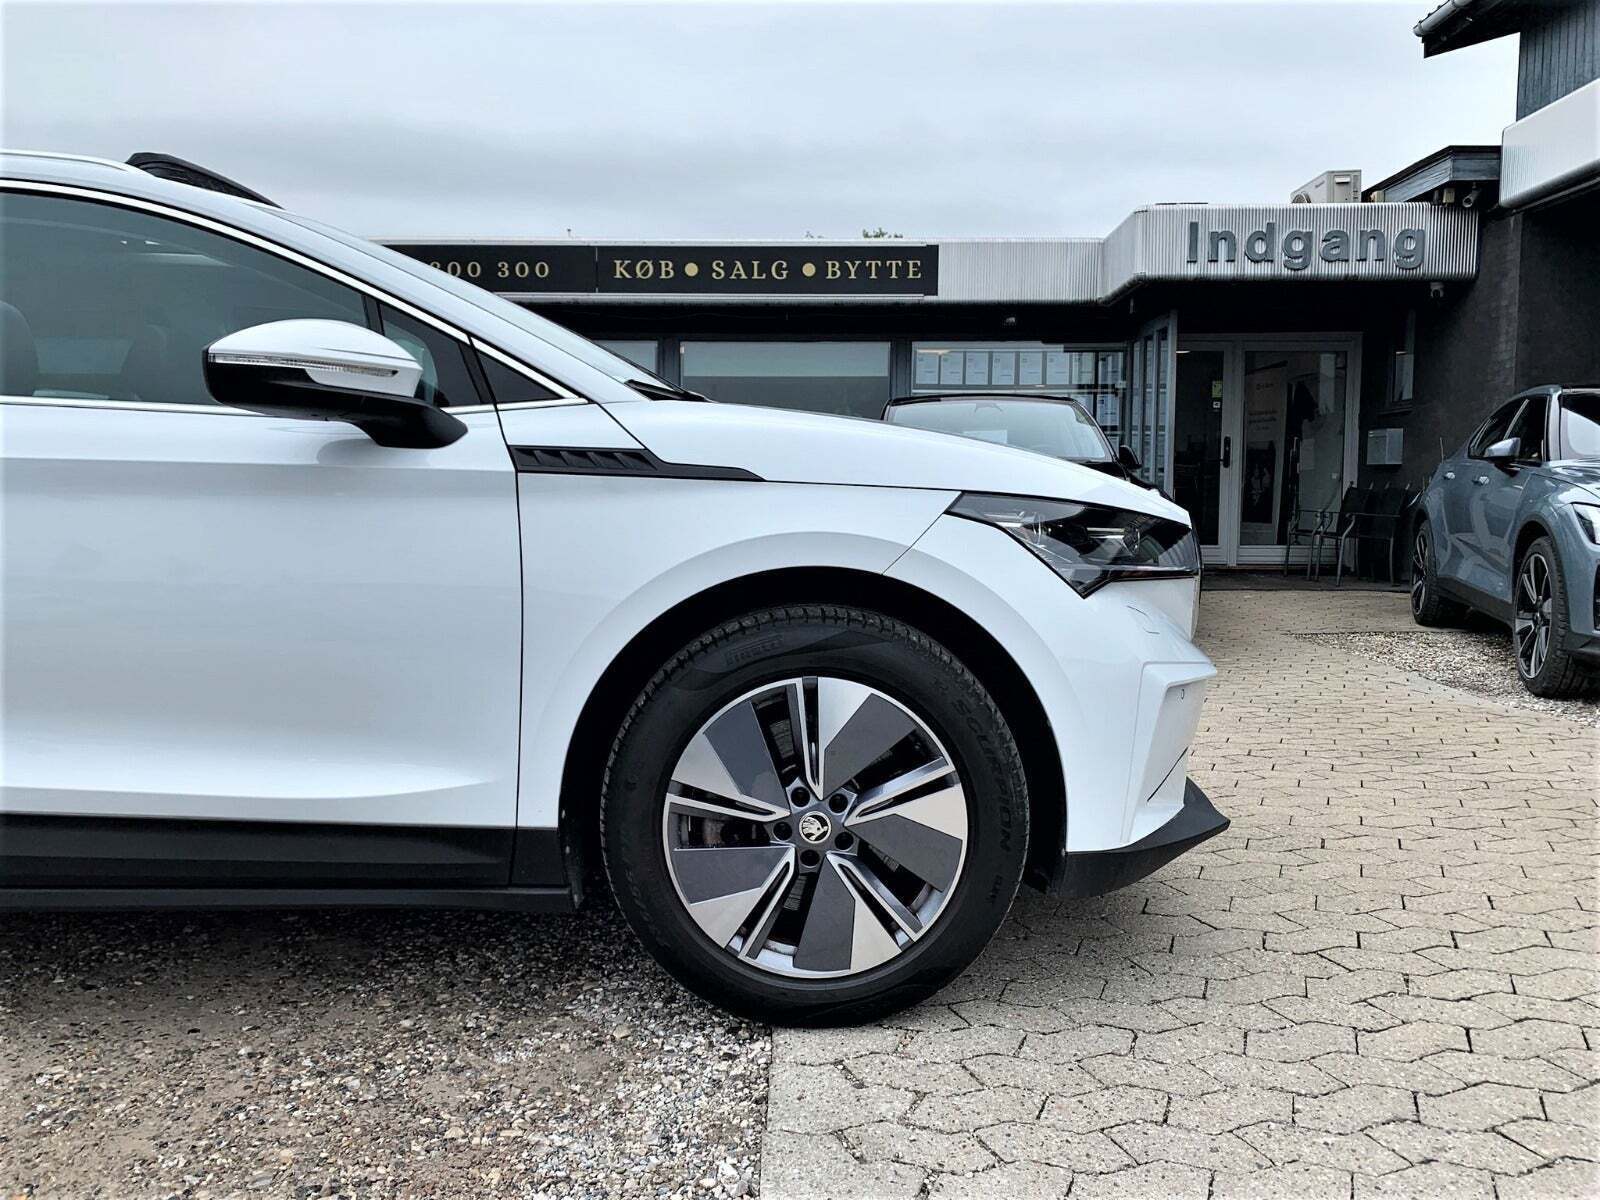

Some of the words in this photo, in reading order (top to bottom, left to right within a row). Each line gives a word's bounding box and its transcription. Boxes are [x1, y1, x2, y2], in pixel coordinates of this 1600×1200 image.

[1187, 220, 1426, 271] Indgang
[497, 261, 550, 278] 300
[613, 260, 675, 280] KØB
[711, 260, 789, 280] SALG
[825, 260, 922, 280] BYTTE
